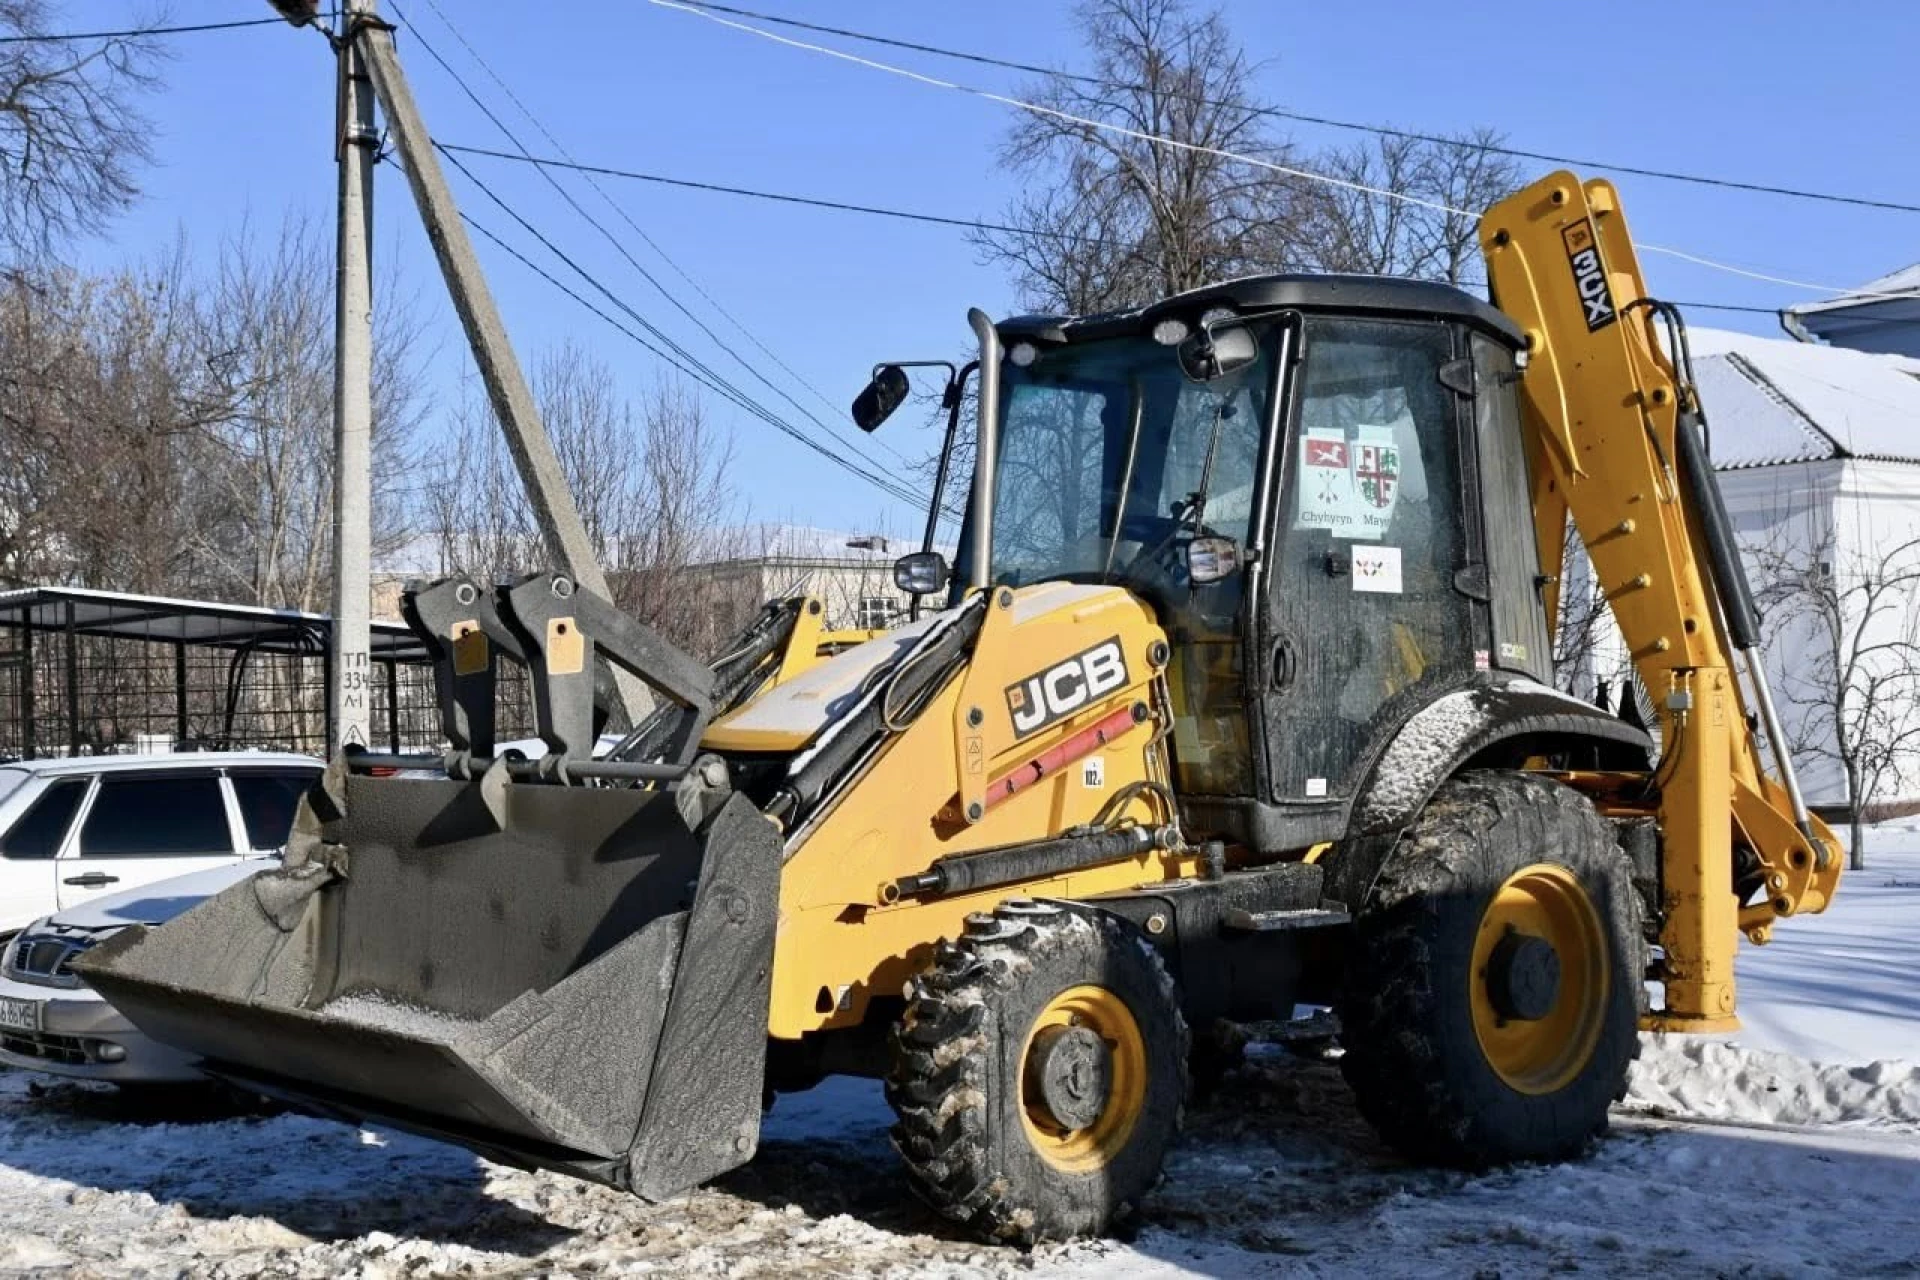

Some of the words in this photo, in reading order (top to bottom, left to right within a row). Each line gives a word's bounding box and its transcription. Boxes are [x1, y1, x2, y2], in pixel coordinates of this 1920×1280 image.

[1573, 249, 1612, 322] 3CX
[343, 653, 367, 668] ТП
[343, 671, 369, 689] 334
[1013, 643, 1126, 731] JCB
